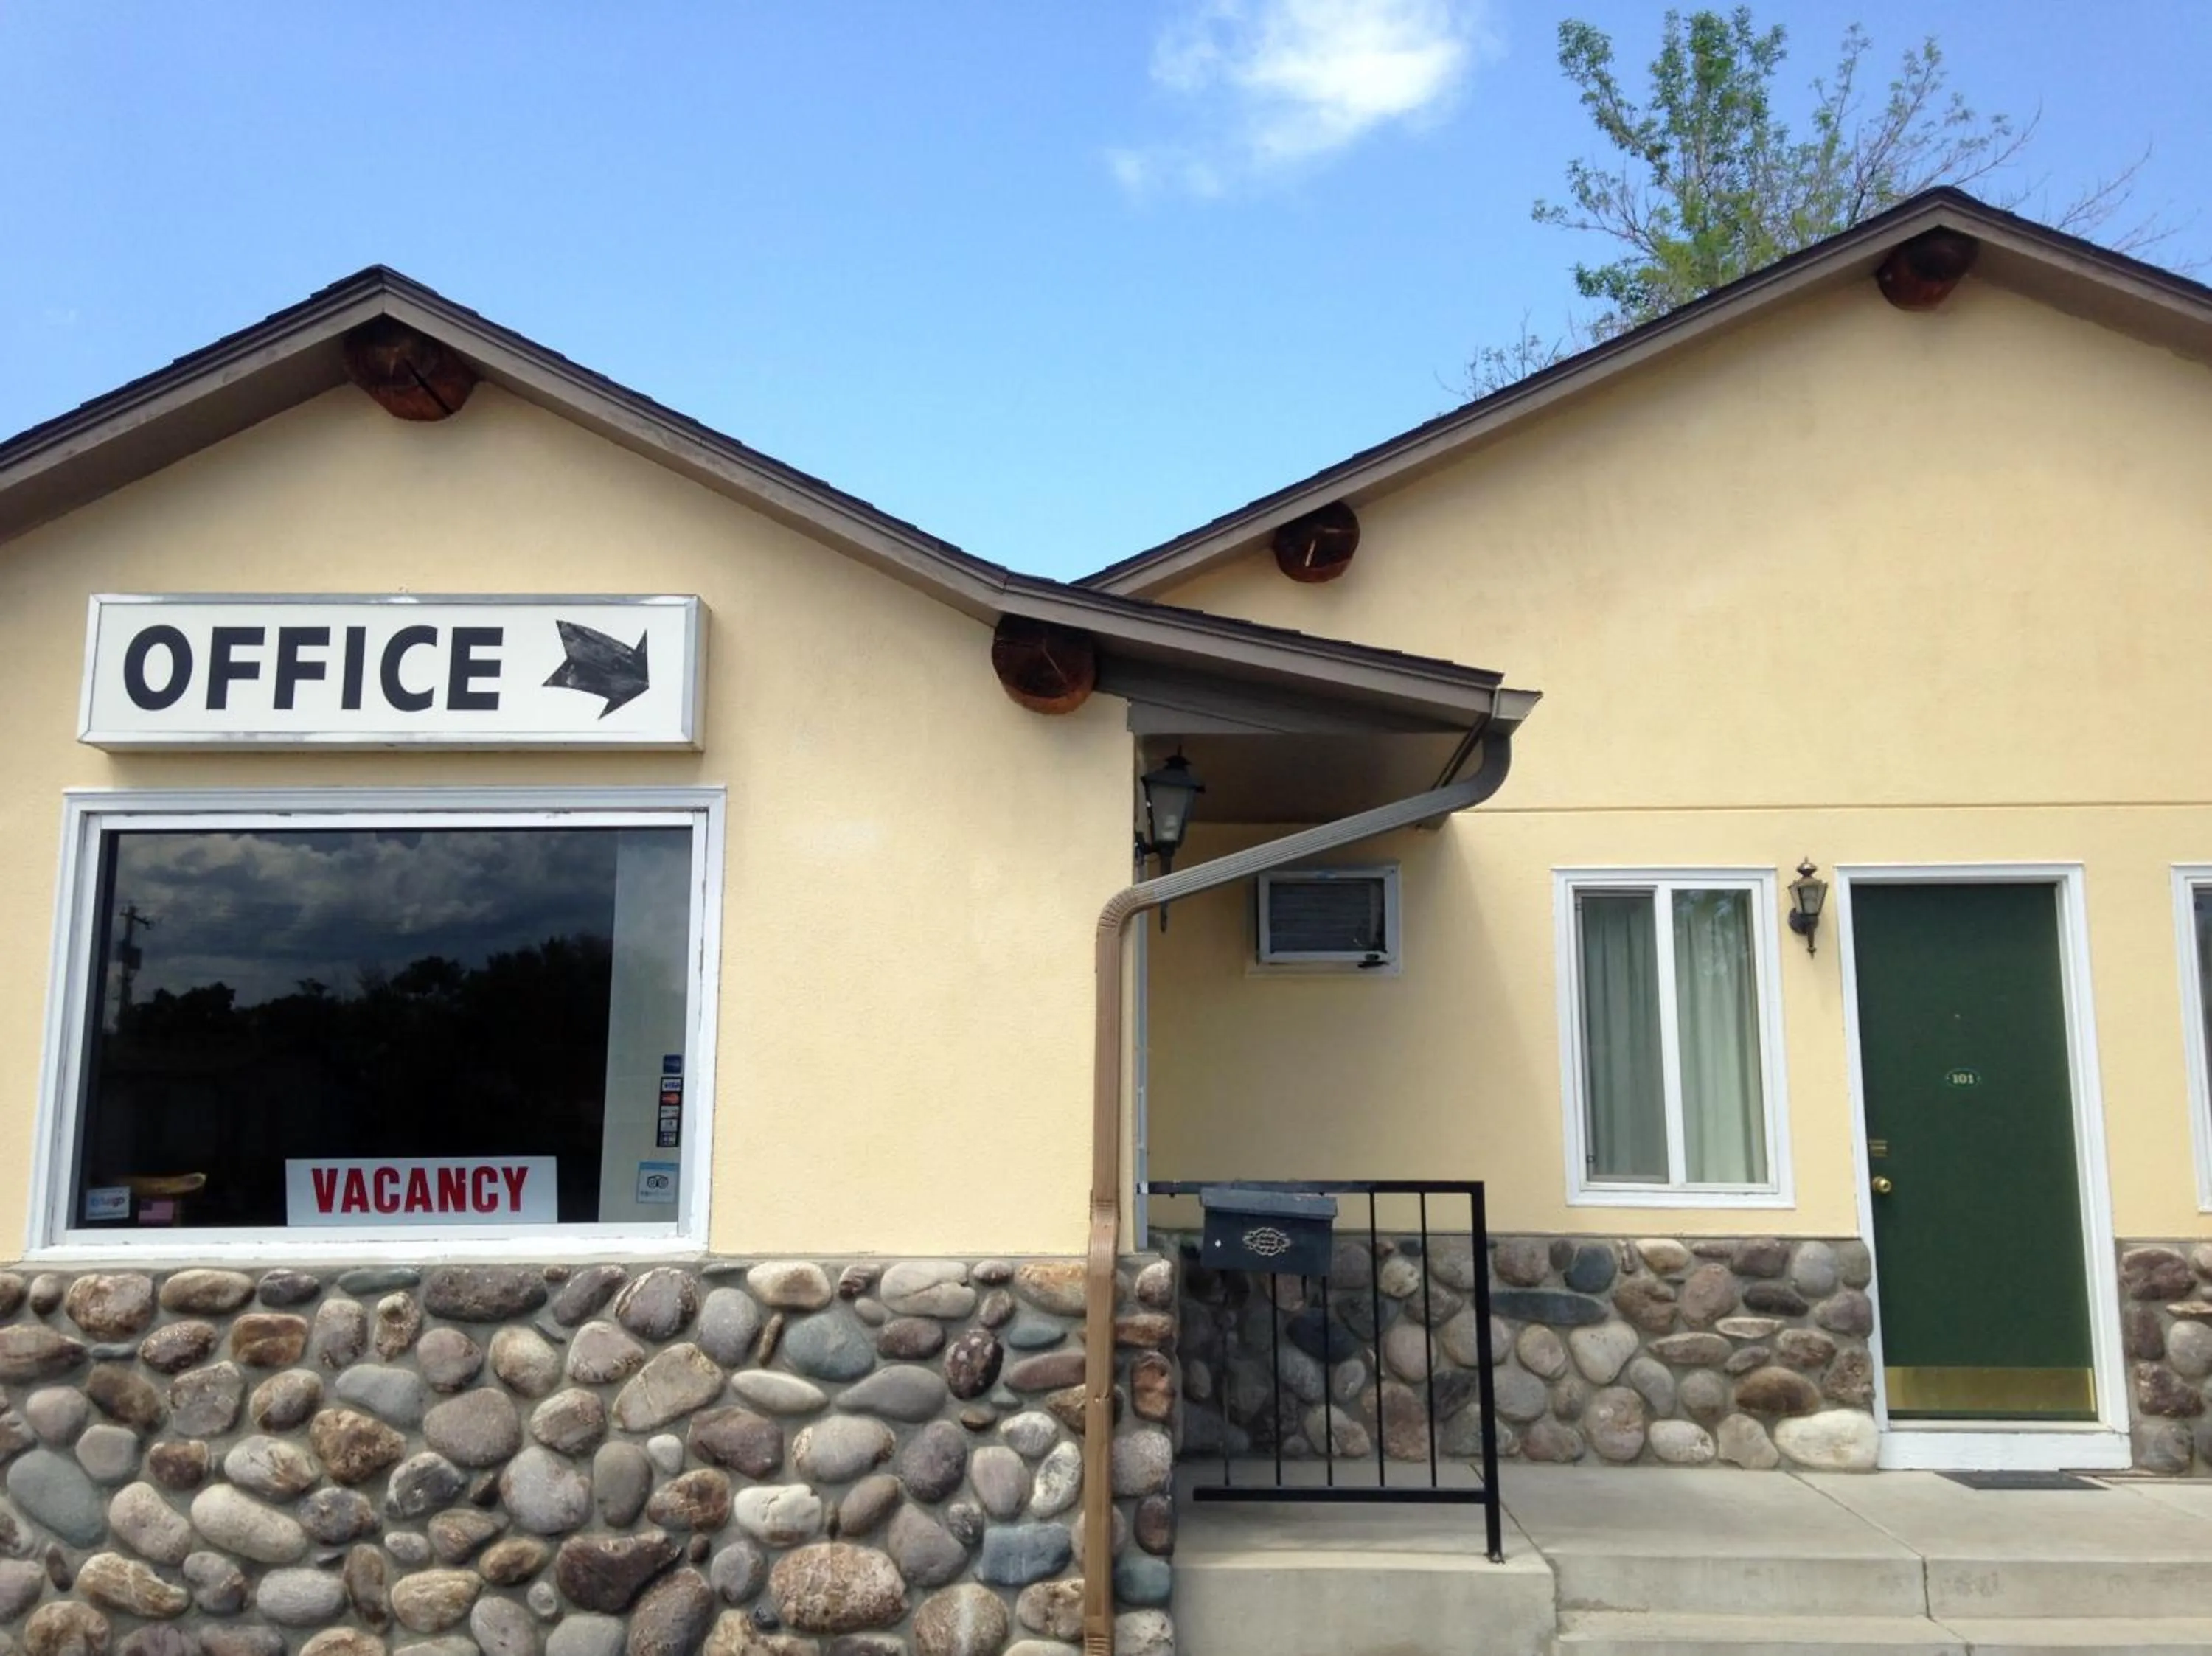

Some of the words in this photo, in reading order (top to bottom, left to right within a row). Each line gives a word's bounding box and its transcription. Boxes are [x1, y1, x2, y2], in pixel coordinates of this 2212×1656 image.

[124, 625, 504, 712] OFFICE
[1952, 1074, 1974, 1084] 101
[312, 1166, 529, 1213] VACANCY
